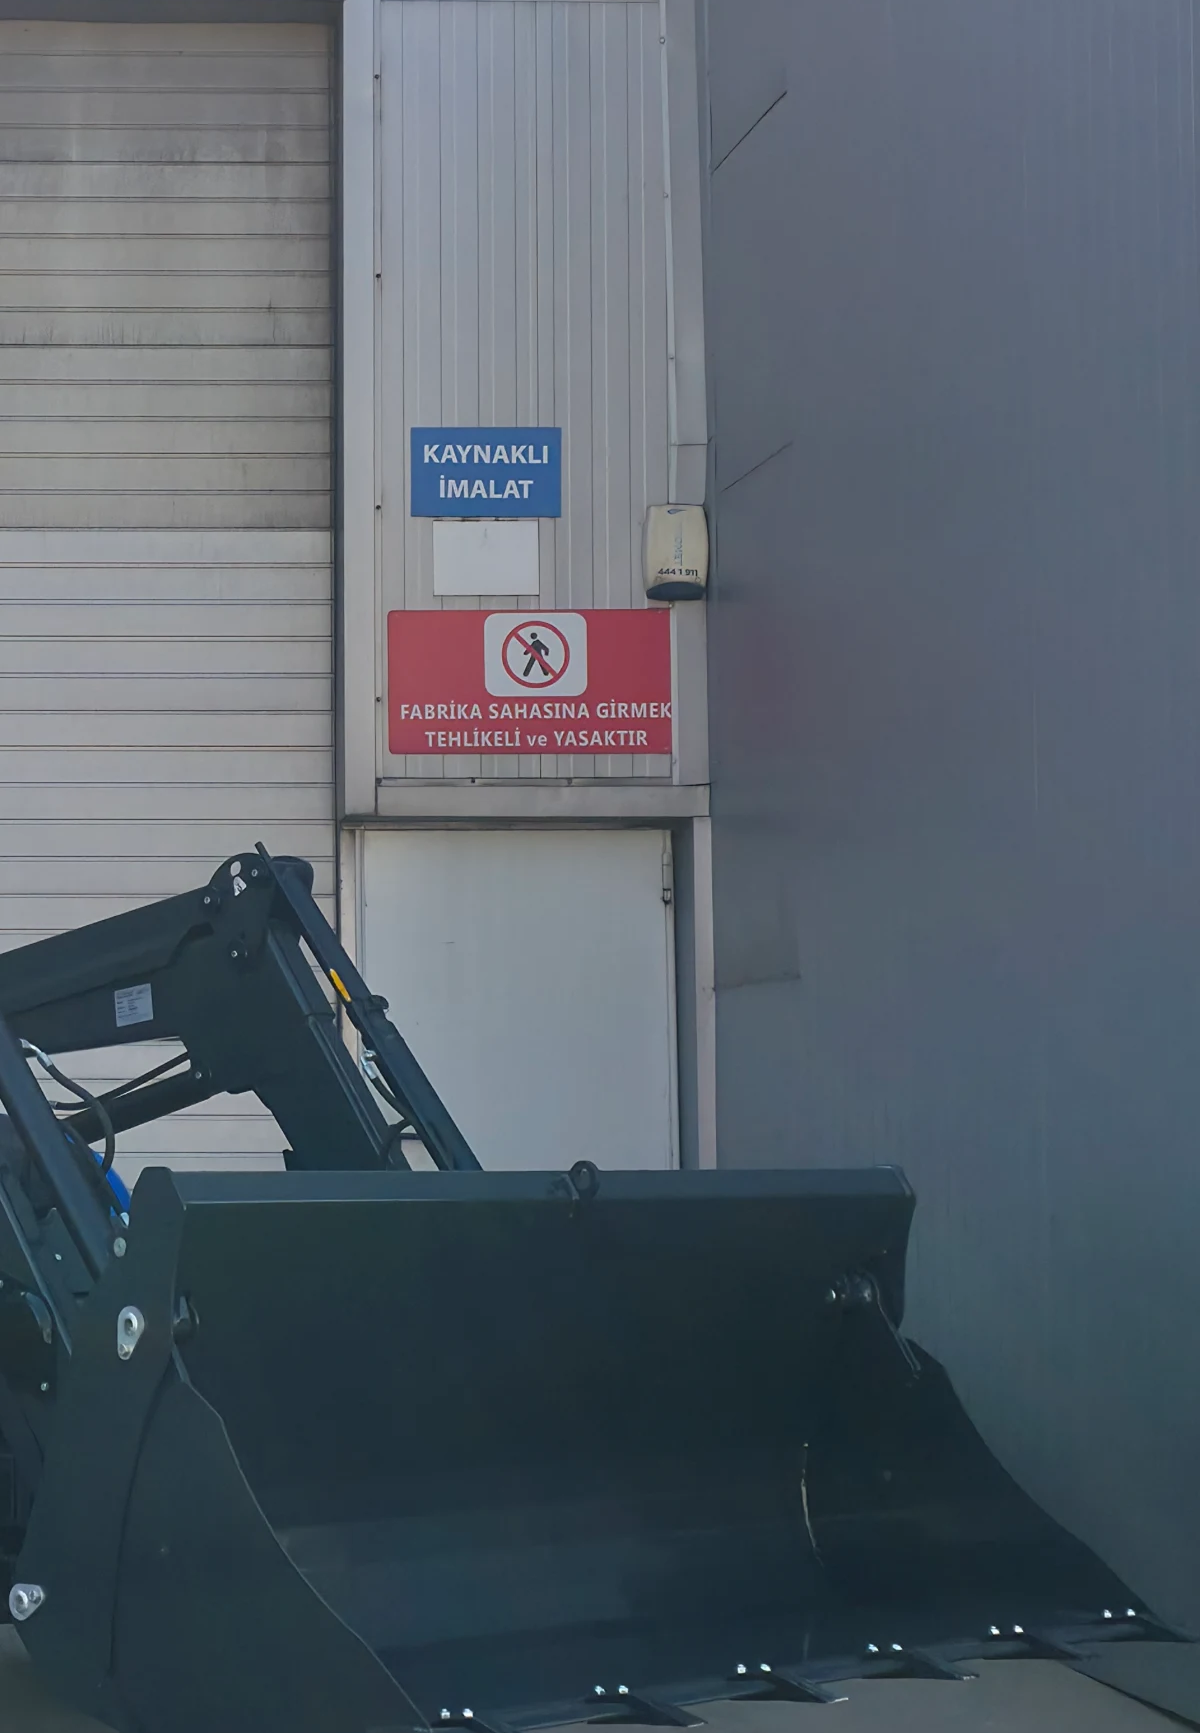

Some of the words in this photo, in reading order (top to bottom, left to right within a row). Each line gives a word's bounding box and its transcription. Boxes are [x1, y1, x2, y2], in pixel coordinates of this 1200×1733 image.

[423, 444, 549, 465] KAYNAKLI
[439, 474, 534, 499] İMALAT
[657, 568, 676, 576] 444
[400, 699, 482, 720] FABRİKA
[488, 703, 590, 719] SAHASINA
[596, 699, 672, 719] GİRMEK
[425, 727, 521, 747] TEHLİKELİ
[527, 733, 548, 747] ve
[553, 730, 648, 747] YASAKTIR
